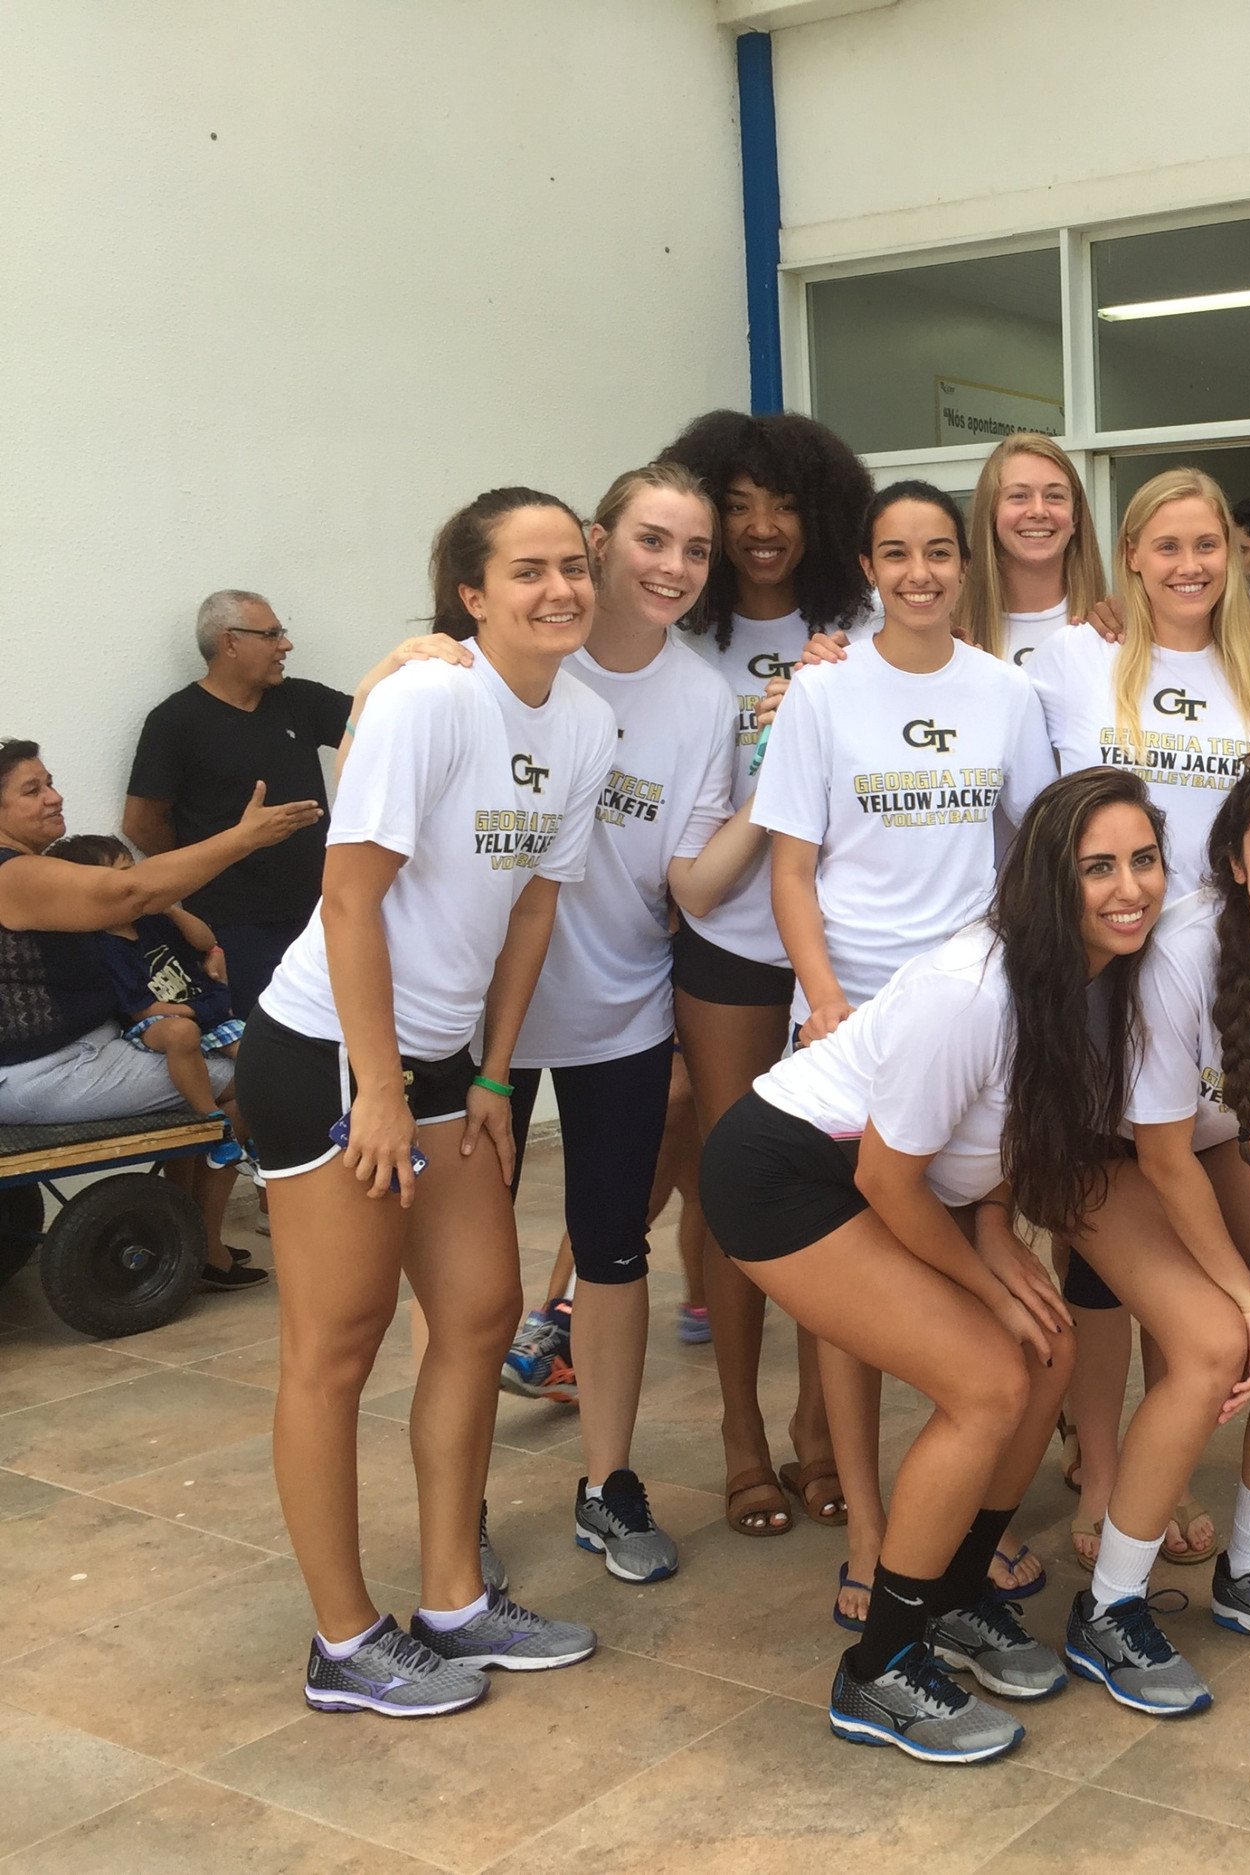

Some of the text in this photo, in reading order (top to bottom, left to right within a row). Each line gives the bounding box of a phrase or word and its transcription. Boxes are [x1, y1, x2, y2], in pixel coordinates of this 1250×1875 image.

[1153, 687, 1207, 721] GT
[902, 719, 958, 753] GT
[510, 753, 550, 794] GT
[1181, 754, 1243, 777] JACKE
[608, 769, 664, 803] TECH
[853, 769, 957, 795] GEORGIA
[857, 788, 1000, 813] YELLOW JACKET
[882, 809, 987, 828] VOLLEYBALL
